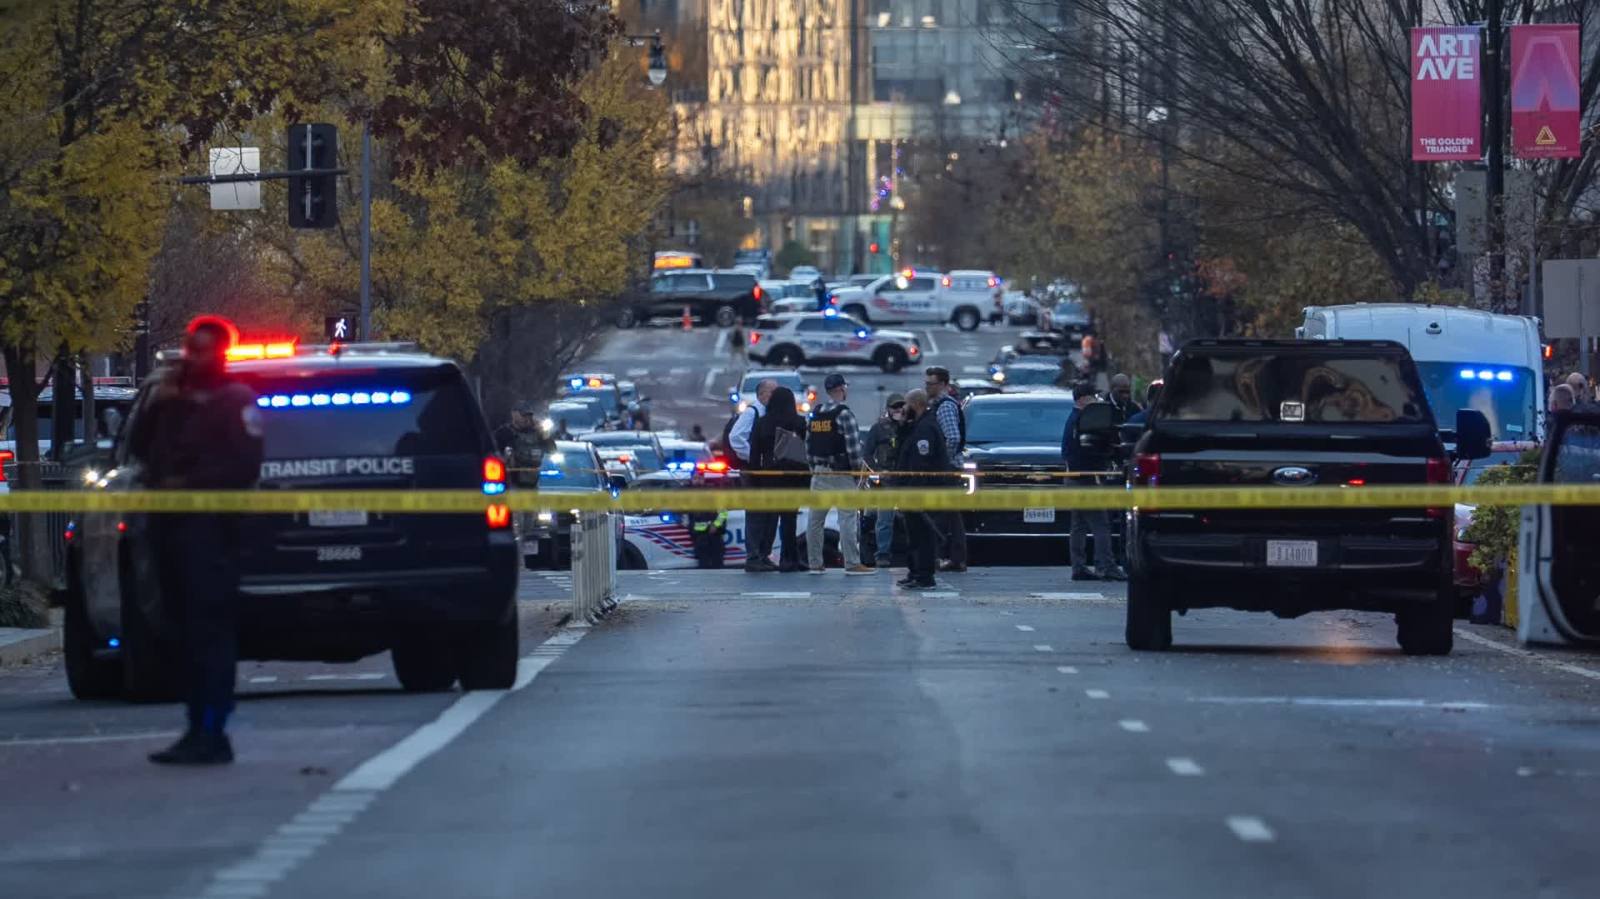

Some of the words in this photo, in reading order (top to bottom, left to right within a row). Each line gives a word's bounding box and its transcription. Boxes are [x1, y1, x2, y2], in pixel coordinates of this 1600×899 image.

[1417, 34, 1475, 57] ART
[1417, 58, 1474, 80] AVE
[1426, 145, 1468, 153] TRIANGLE
[260, 459, 338, 478] TRANSIT
[345, 457, 414, 475] POLICE
